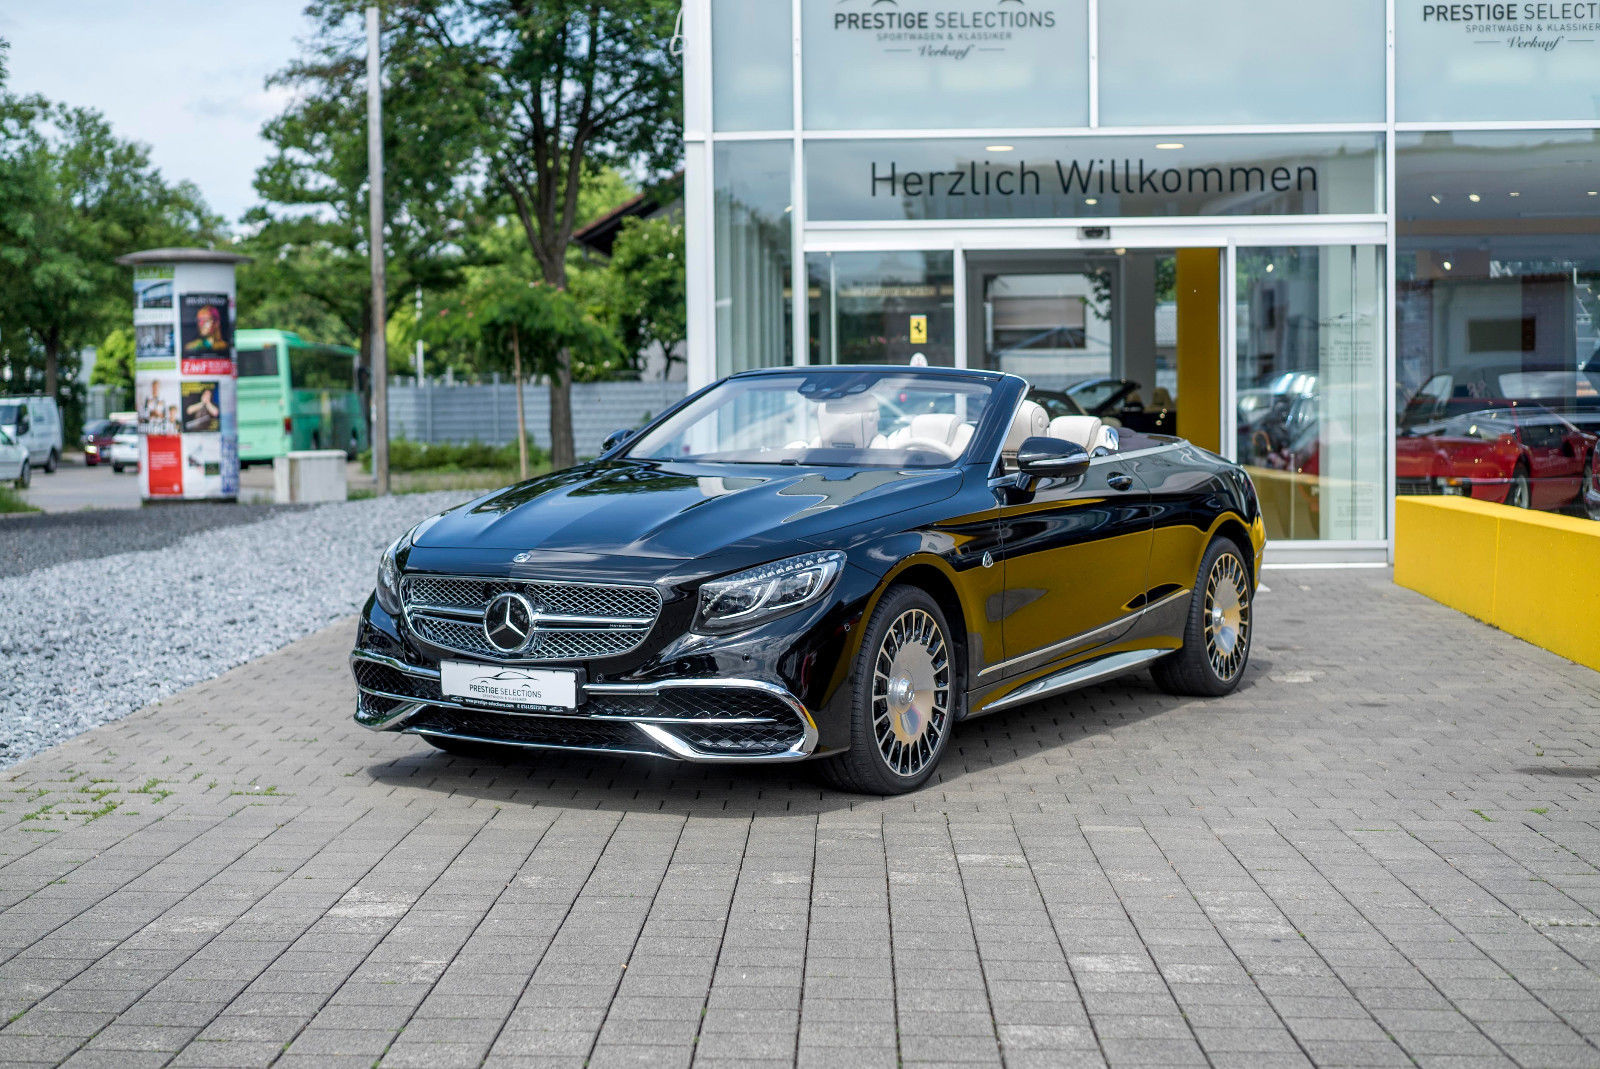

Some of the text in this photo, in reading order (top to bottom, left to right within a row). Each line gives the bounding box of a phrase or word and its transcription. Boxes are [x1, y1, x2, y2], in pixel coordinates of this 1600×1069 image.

[1423, 3, 1600, 21] PRESTIGE SELECT
[834, 11, 1056, 30] PRESTIGE SELECTIONS
[1465, 23, 1600, 33] SPORTWAGEN & KLASSIKER
[876, 31, 1013, 41] SPORTWAGEN & KLASSIKER
[1507, 35, 1564, 52] Verkauf
[917, 44, 975, 59] Verkauf
[870, 159, 1318, 197] Herzlich Willkommen
[469, 684, 542, 699] PRESTIGE SELECTIONS
